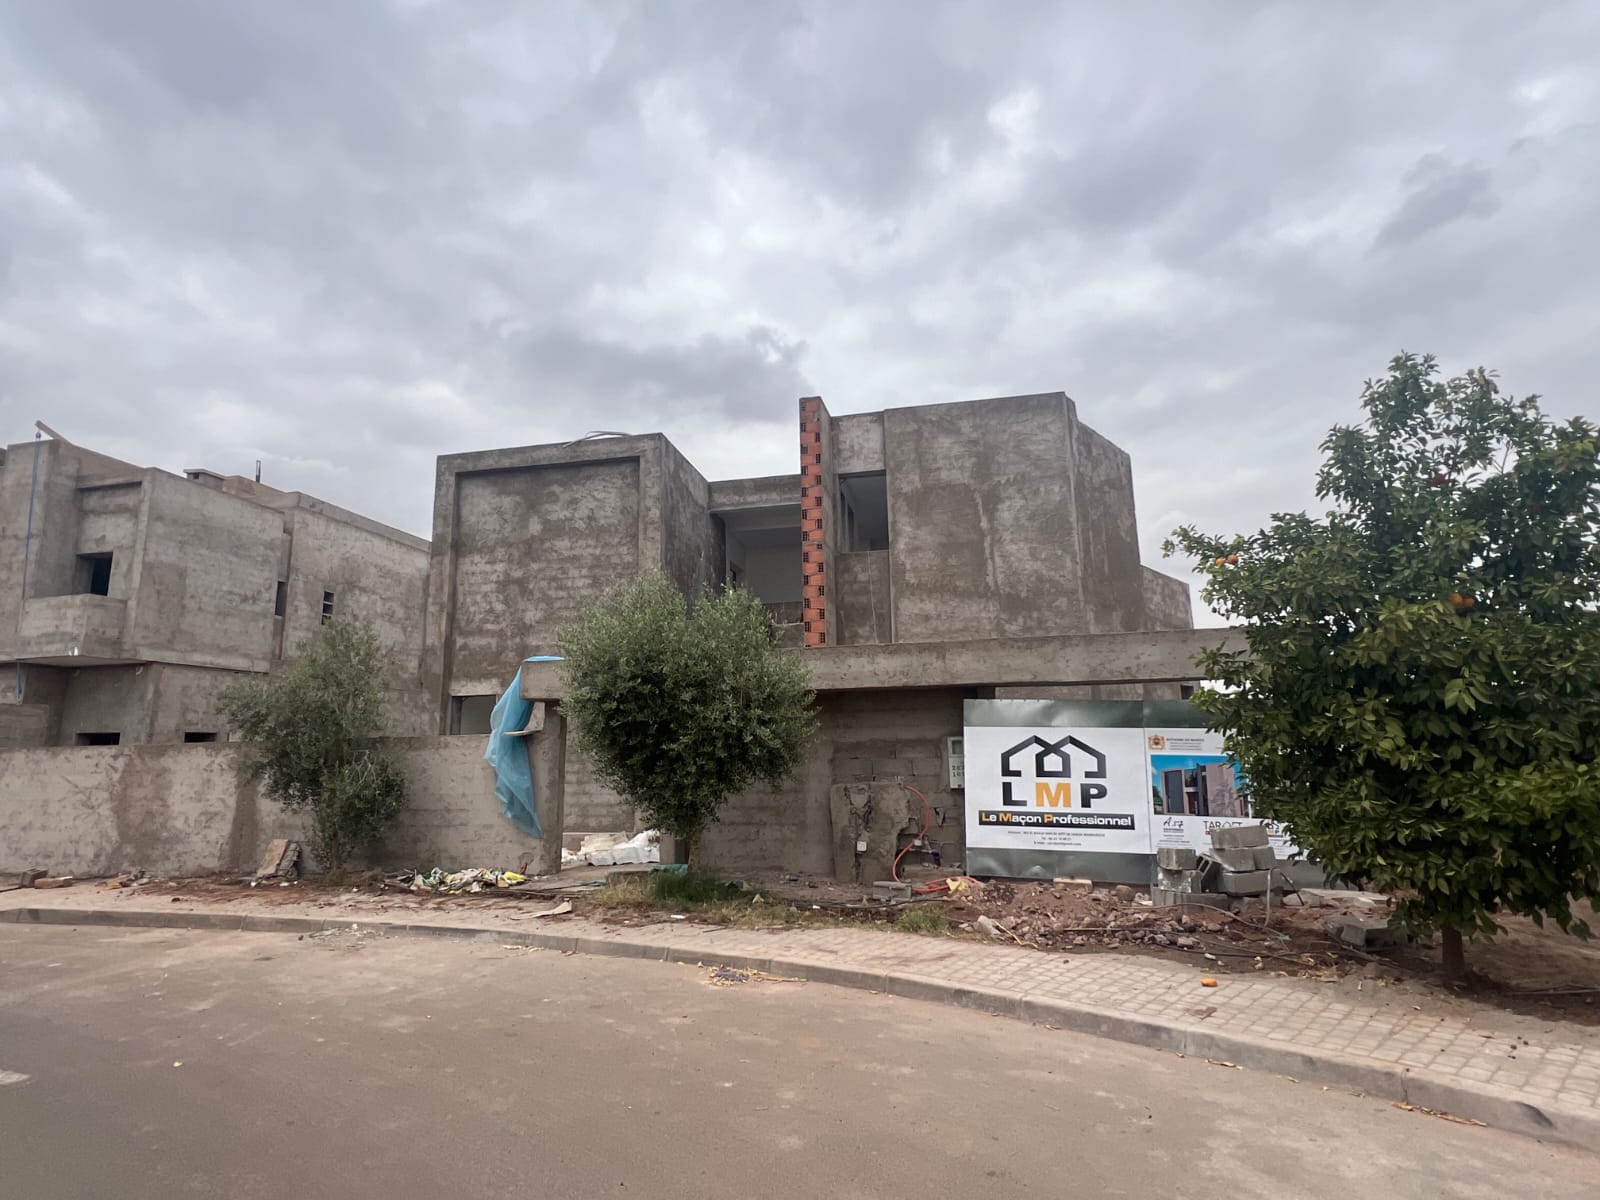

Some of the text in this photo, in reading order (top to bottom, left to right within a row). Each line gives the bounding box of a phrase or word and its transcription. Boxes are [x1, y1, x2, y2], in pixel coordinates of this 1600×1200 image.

[1002, 781, 1108, 808] LMP
[981, 812, 1132, 826] Le Maçon Professionnel
